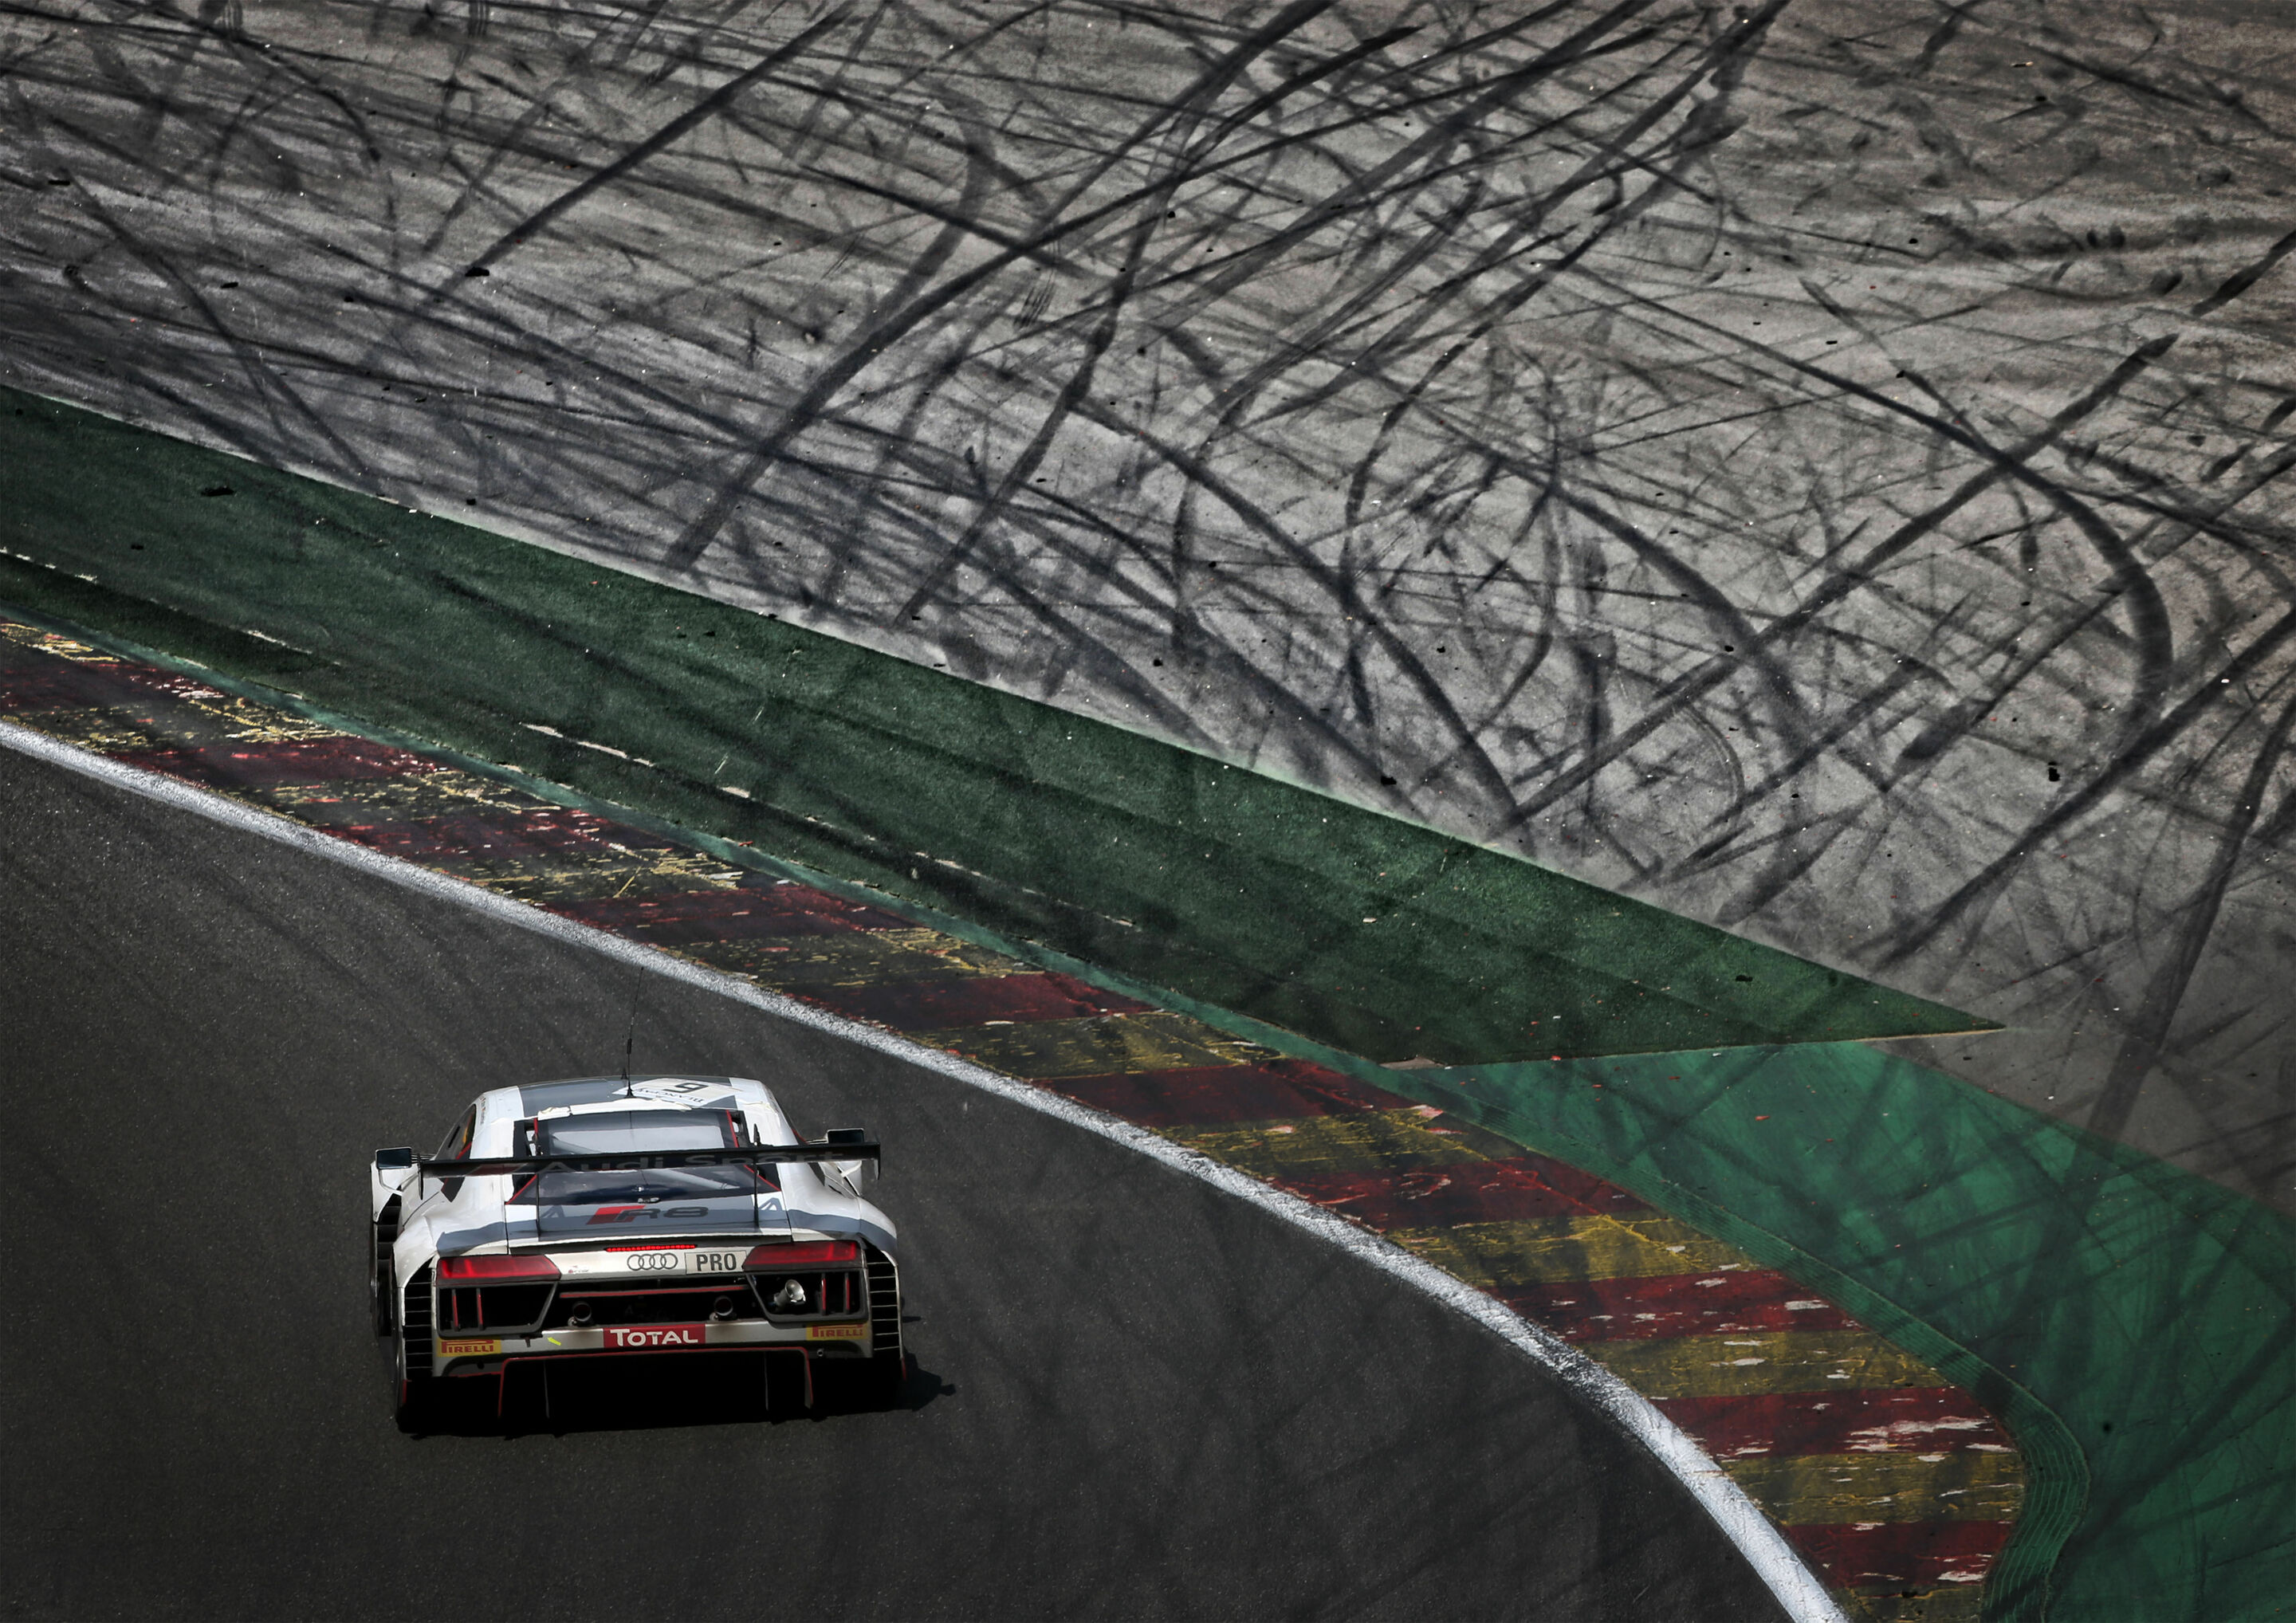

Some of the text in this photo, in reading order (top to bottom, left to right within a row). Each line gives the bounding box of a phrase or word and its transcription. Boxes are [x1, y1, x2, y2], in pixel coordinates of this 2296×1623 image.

[537, 1157, 663, 1173] Audi
[614, 1206, 709, 1222] R8
[696, 1253, 737, 1271] PRO
[610, 1328, 698, 1346] TOTAL
[812, 1324, 863, 1338] PIRELLI
[442, 1339, 493, 1354] PIRELLI
